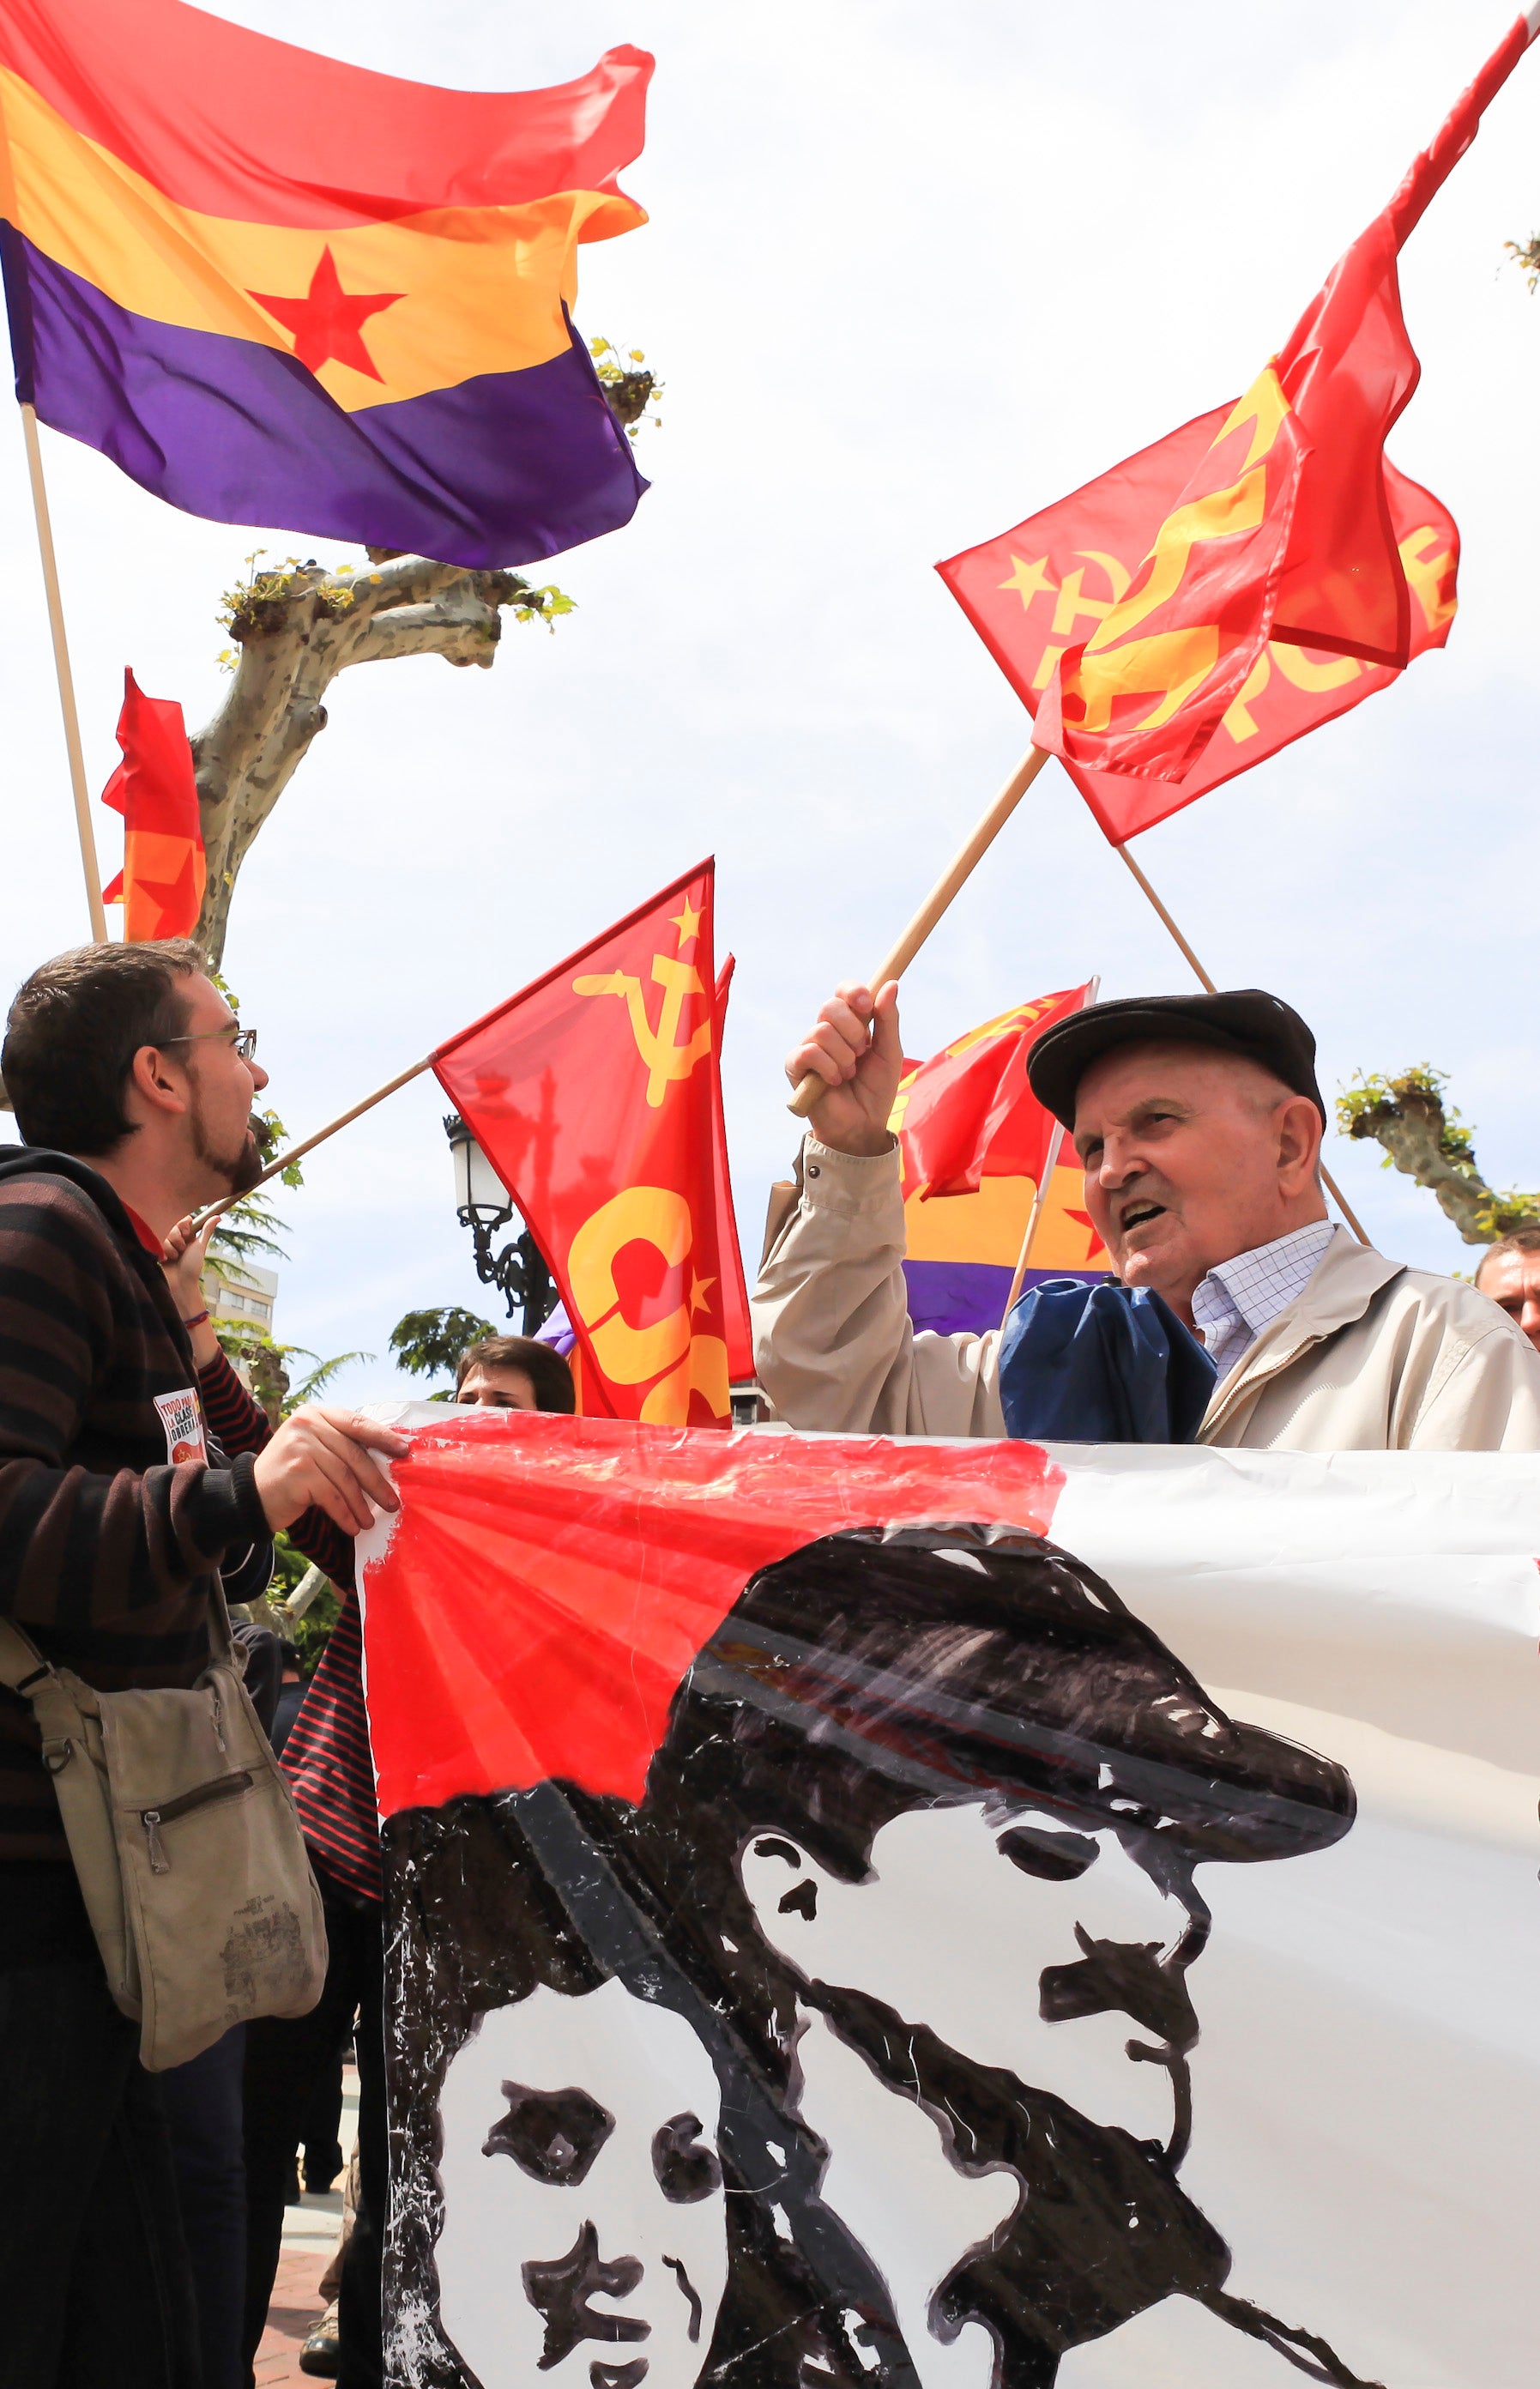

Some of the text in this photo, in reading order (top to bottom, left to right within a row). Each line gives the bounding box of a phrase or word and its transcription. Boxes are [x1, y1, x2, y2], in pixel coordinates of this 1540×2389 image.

[161, 1399, 182, 1417] TODO
[167, 1406, 193, 1429] LA CLASE
